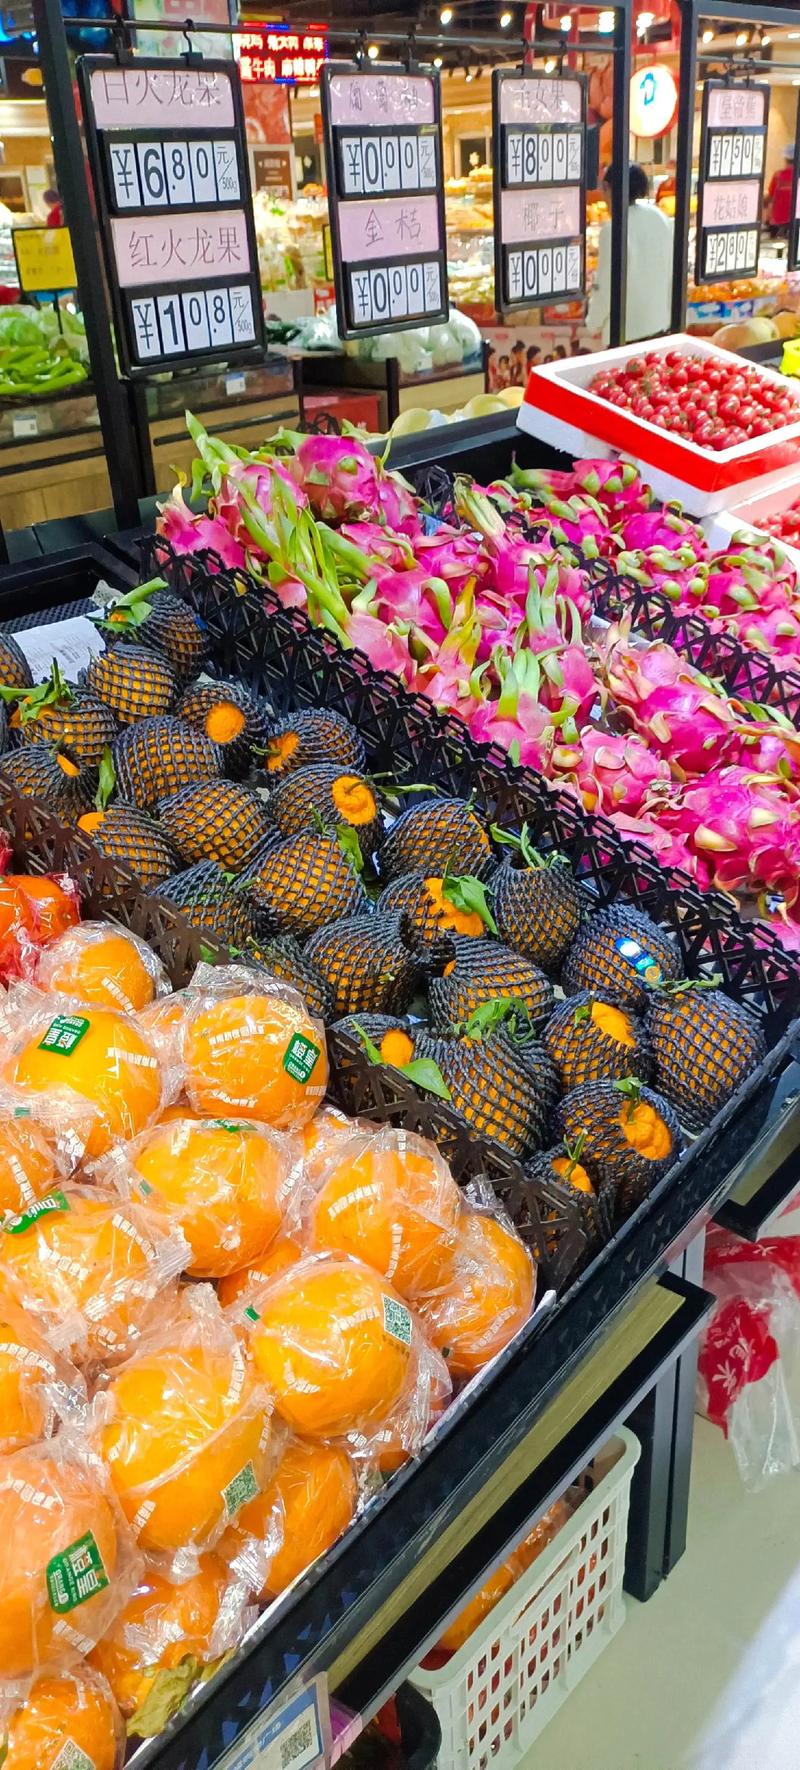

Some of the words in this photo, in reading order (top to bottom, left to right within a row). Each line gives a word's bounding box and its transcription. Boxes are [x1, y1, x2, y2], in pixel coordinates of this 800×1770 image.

[365, 208, 422, 247] 金桔
[522, 199, 568, 233] 椰子
[128, 226, 242, 268] 红火龙果
